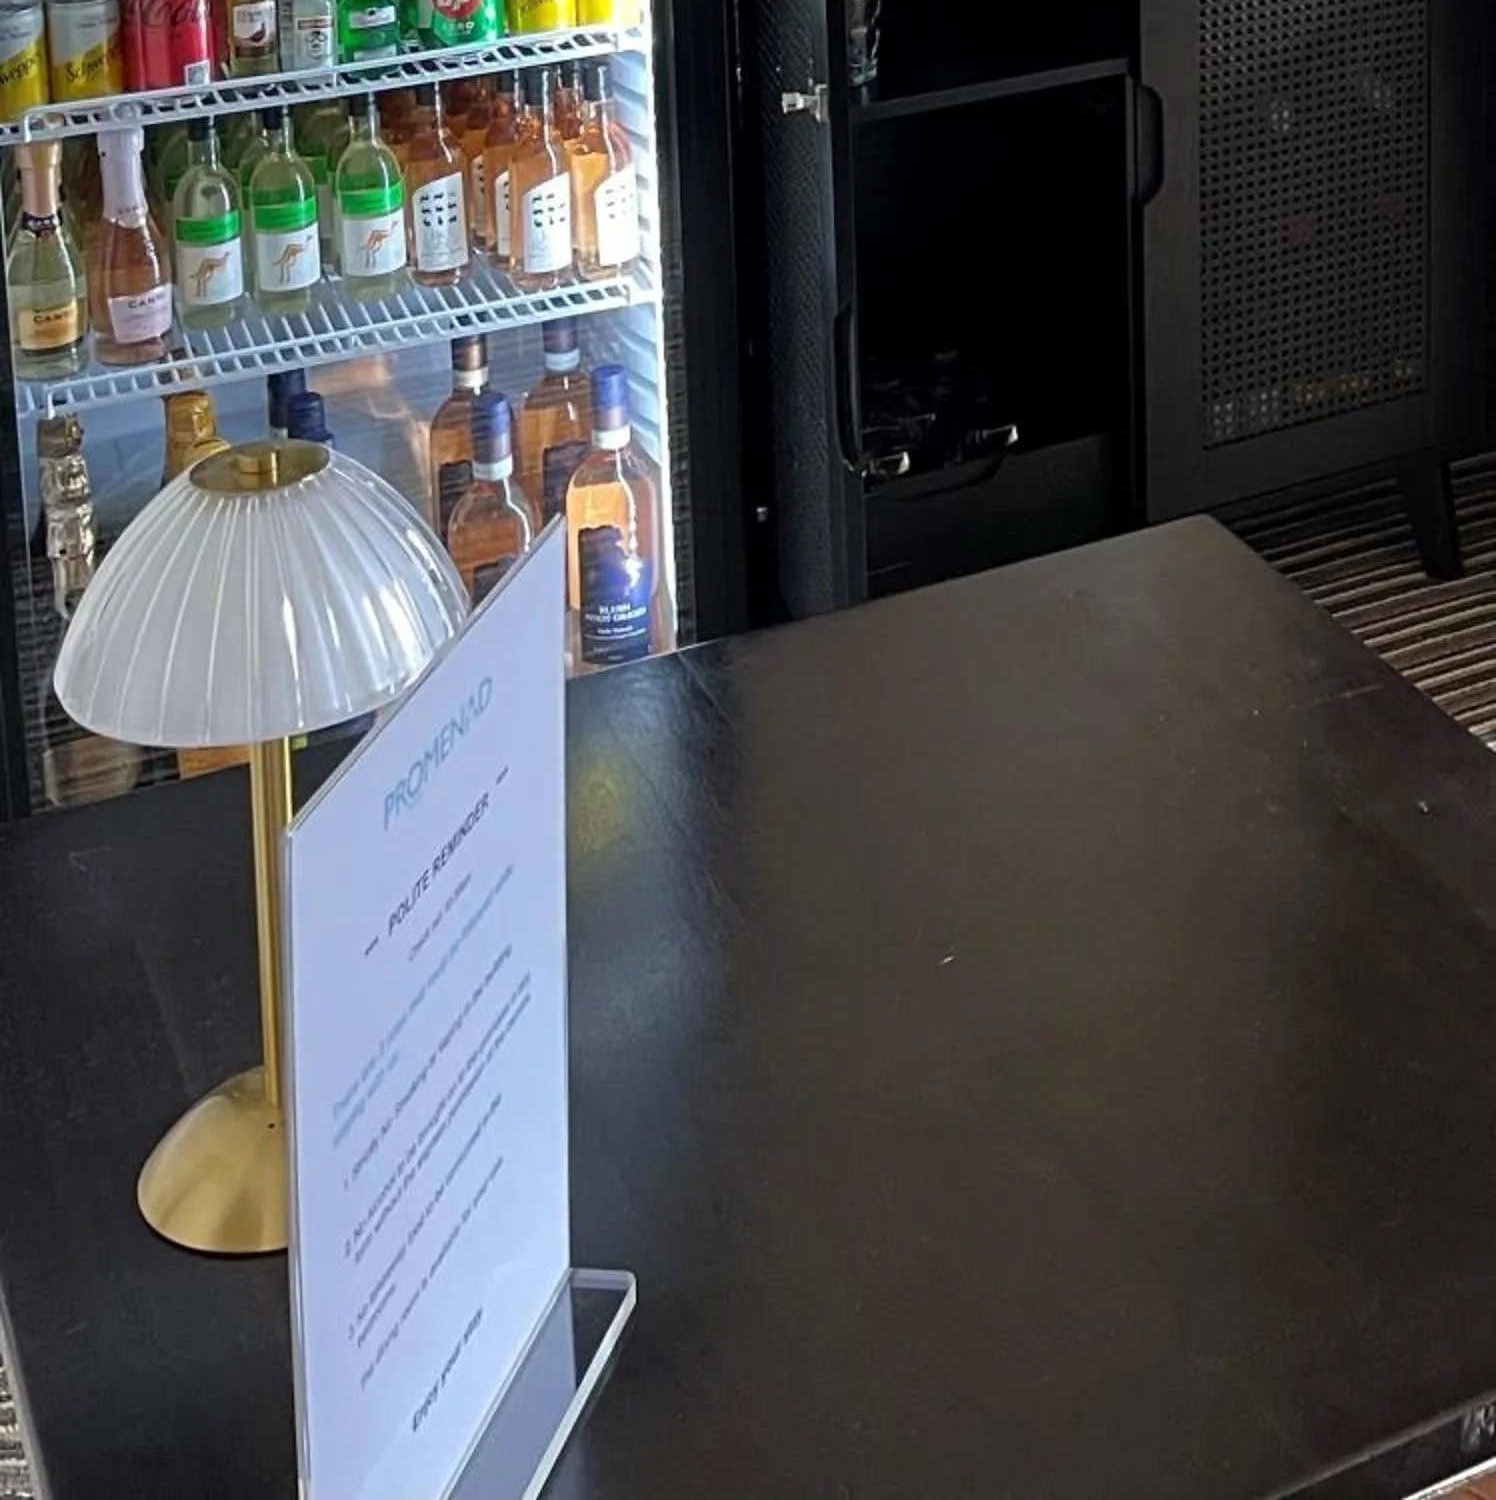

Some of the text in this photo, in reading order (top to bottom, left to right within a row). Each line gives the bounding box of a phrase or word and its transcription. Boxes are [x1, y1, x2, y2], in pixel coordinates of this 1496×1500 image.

[384, 677, 492, 831] PROMENAD
[389, 793, 489, 936] POLITE REMINDER
